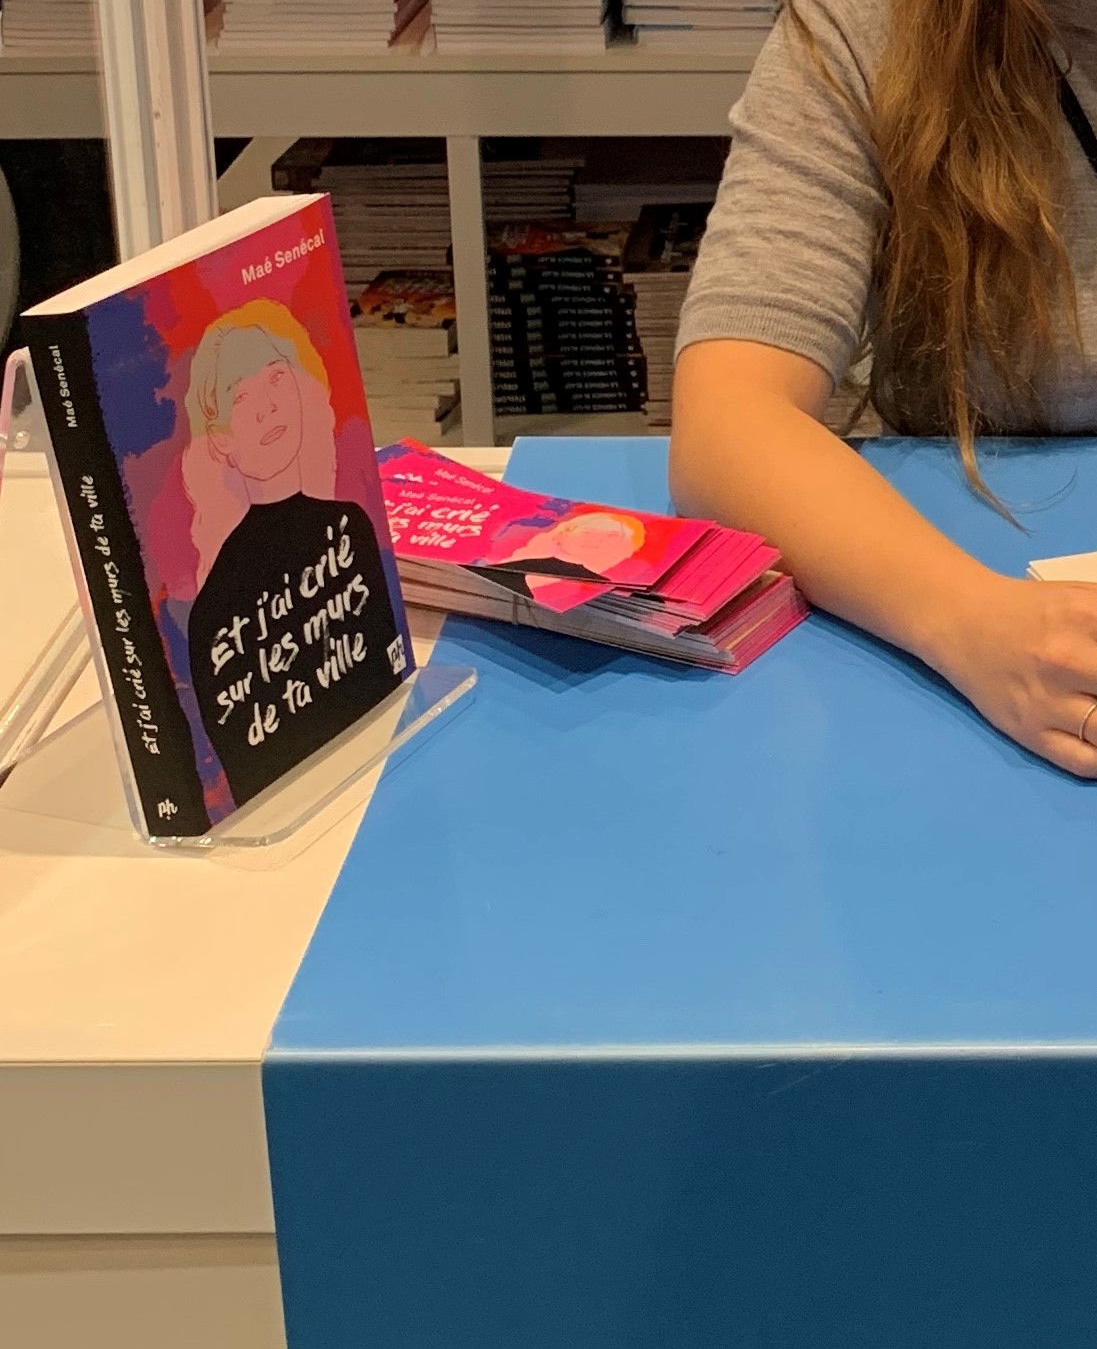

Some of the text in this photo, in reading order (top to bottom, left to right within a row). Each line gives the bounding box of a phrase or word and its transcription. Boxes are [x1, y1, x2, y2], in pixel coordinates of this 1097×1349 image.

[241, 228, 325, 285] Maé Senécal
[51, 345, 78, 428] Maé Senécal
[80, 474, 97, 509] ville
[89, 513, 105, 532] ta
[388, 517, 482, 537] es murs
[431, 504, 499, 522] crié
[95, 536, 111, 556] de
[410, 532, 456, 548] ville
[104, 561, 132, 604] murs
[211, 514, 355, 675] Et j'ai crié
[115, 608, 132, 633] les
[123, 638, 142, 666] sur
[217, 574, 370, 725] sur les murs
[122, 668, 147, 700] crié
[248, 632, 368, 746] de ta ville
[132, 703, 158, 733] j'ai
